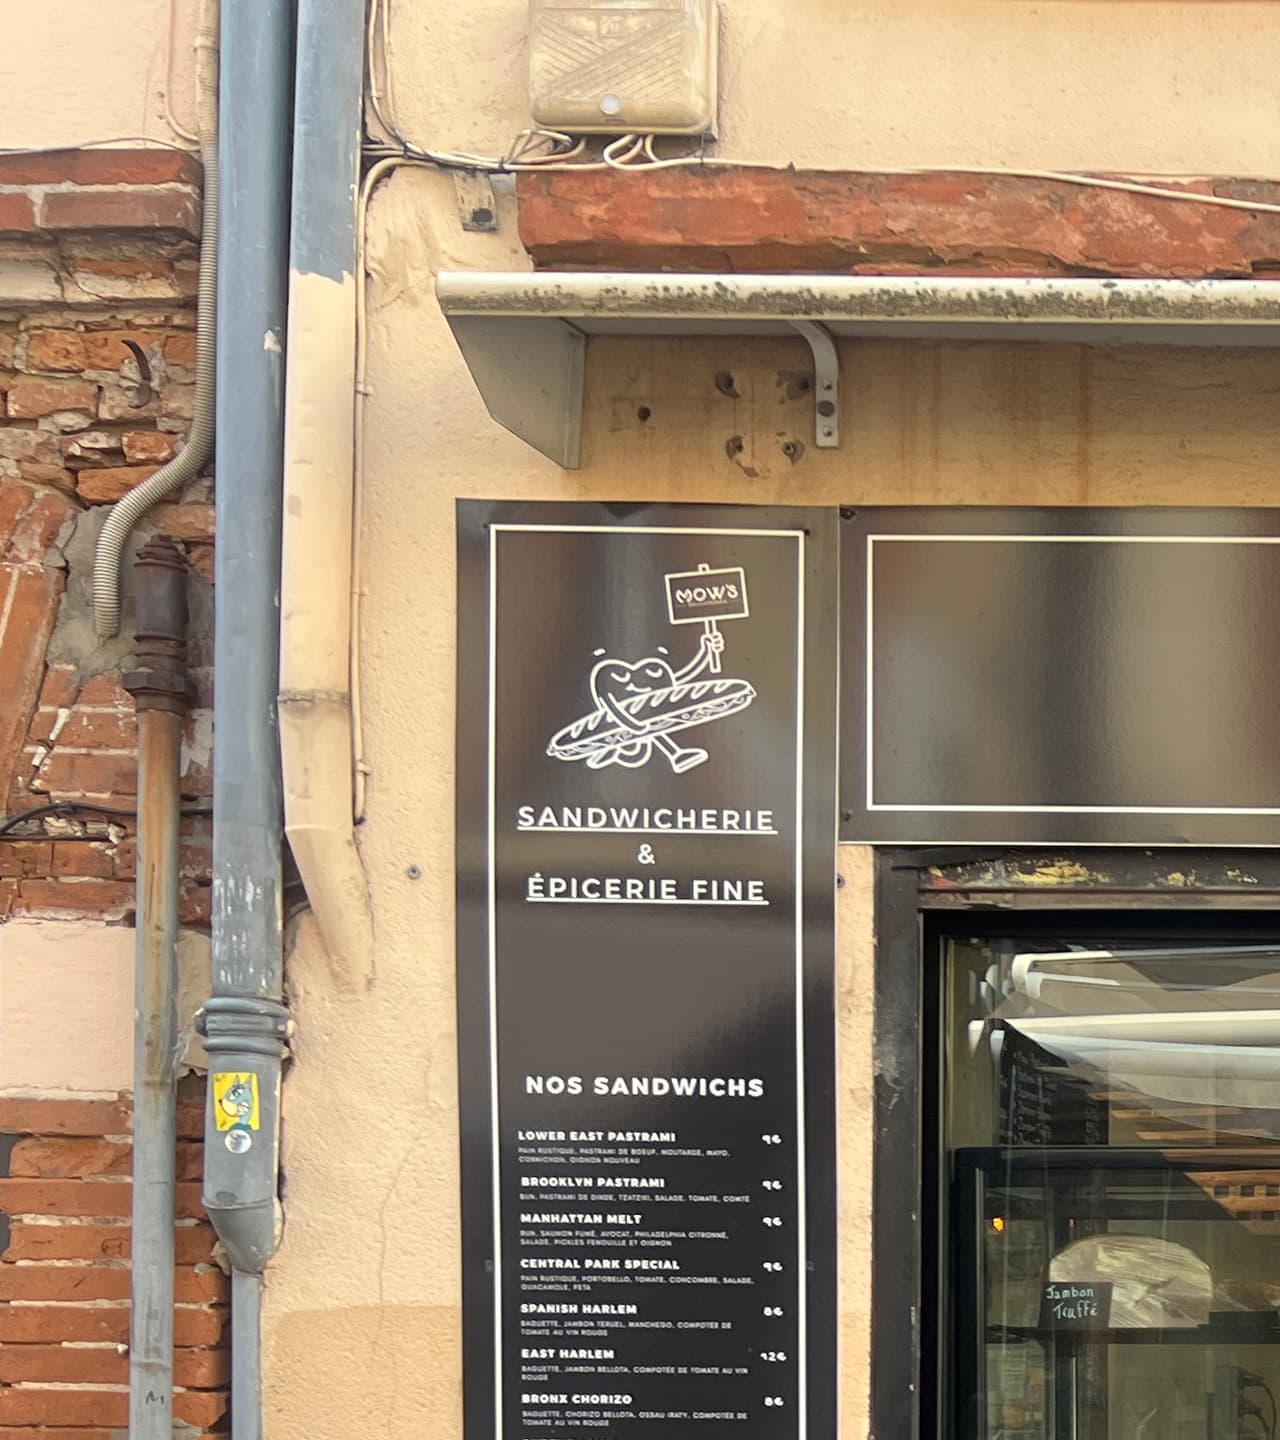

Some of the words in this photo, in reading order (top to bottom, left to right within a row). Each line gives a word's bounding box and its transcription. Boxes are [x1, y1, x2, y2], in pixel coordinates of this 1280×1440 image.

[675, 583, 738, 604] MOW'S
[517, 806, 775, 830] SANDWICHERIE
[637, 843, 656, 865] &
[527, 872, 678, 901] ÉPICERIE
[691, 879, 765, 901] FINE
[525, 1075, 583, 1095] NOS
[593, 1076, 764, 1097] SANDWICHS
[517, 1130, 566, 1141] LOWER
[569, 1131, 604, 1142] EAST
[607, 1131, 676, 1142] PASTRAMI
[617, 1147, 629, 1156] DE
[520, 1176, 593, 1187] BROOKLYN
[596, 1177, 665, 1188] PASTRAMI
[520, 1213, 603, 1224] MANHATTAN
[606, 1214, 642, 1225] MELT
[519, 1258, 582, 1269] CENTRAL
[584, 1258, 621, 1269] PARK
[624, 1259, 681, 1270] SPECIAL
[1046, 1286, 1094, 1299] Jambon
[520, 1303, 579, 1314] SPANISH
[581, 1303, 638, 1315] HARLEM
[520, 1348, 556, 1359] EAST
[559, 1348, 615, 1360] HARLEM
[521, 1393, 569, 1404] BRONX
[571, 1394, 633, 1405] CHORIZO
